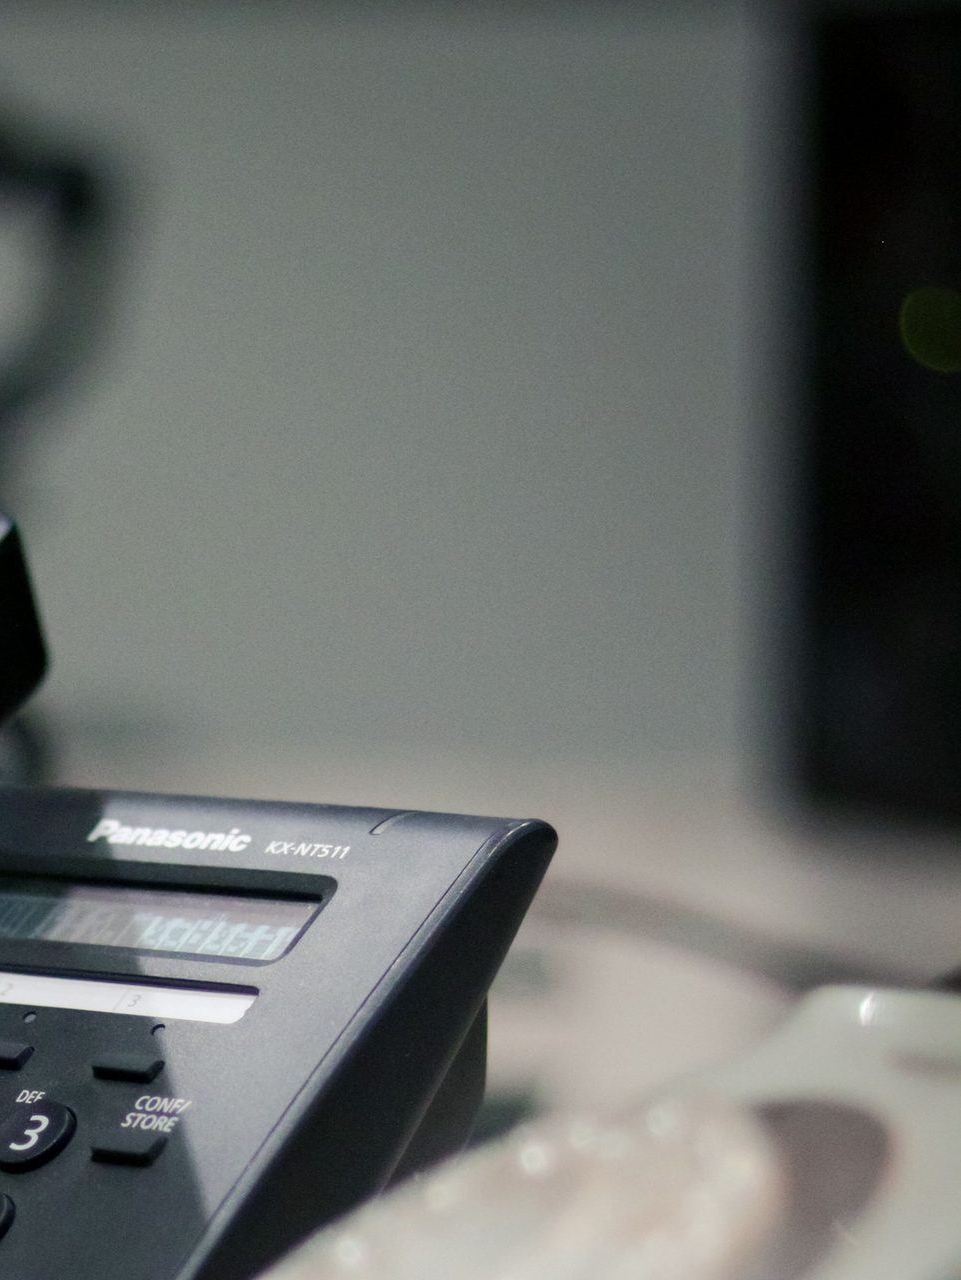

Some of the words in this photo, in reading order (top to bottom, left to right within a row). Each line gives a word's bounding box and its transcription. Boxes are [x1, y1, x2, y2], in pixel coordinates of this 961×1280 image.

[87, 819, 252, 852] Panasonic
[263, 840, 351, 860] KX-NT511
[134, 1095, 193, 1114] CONF/
[9, 1114, 49, 1150] 3
[120, 1112, 179, 1133] STORE
